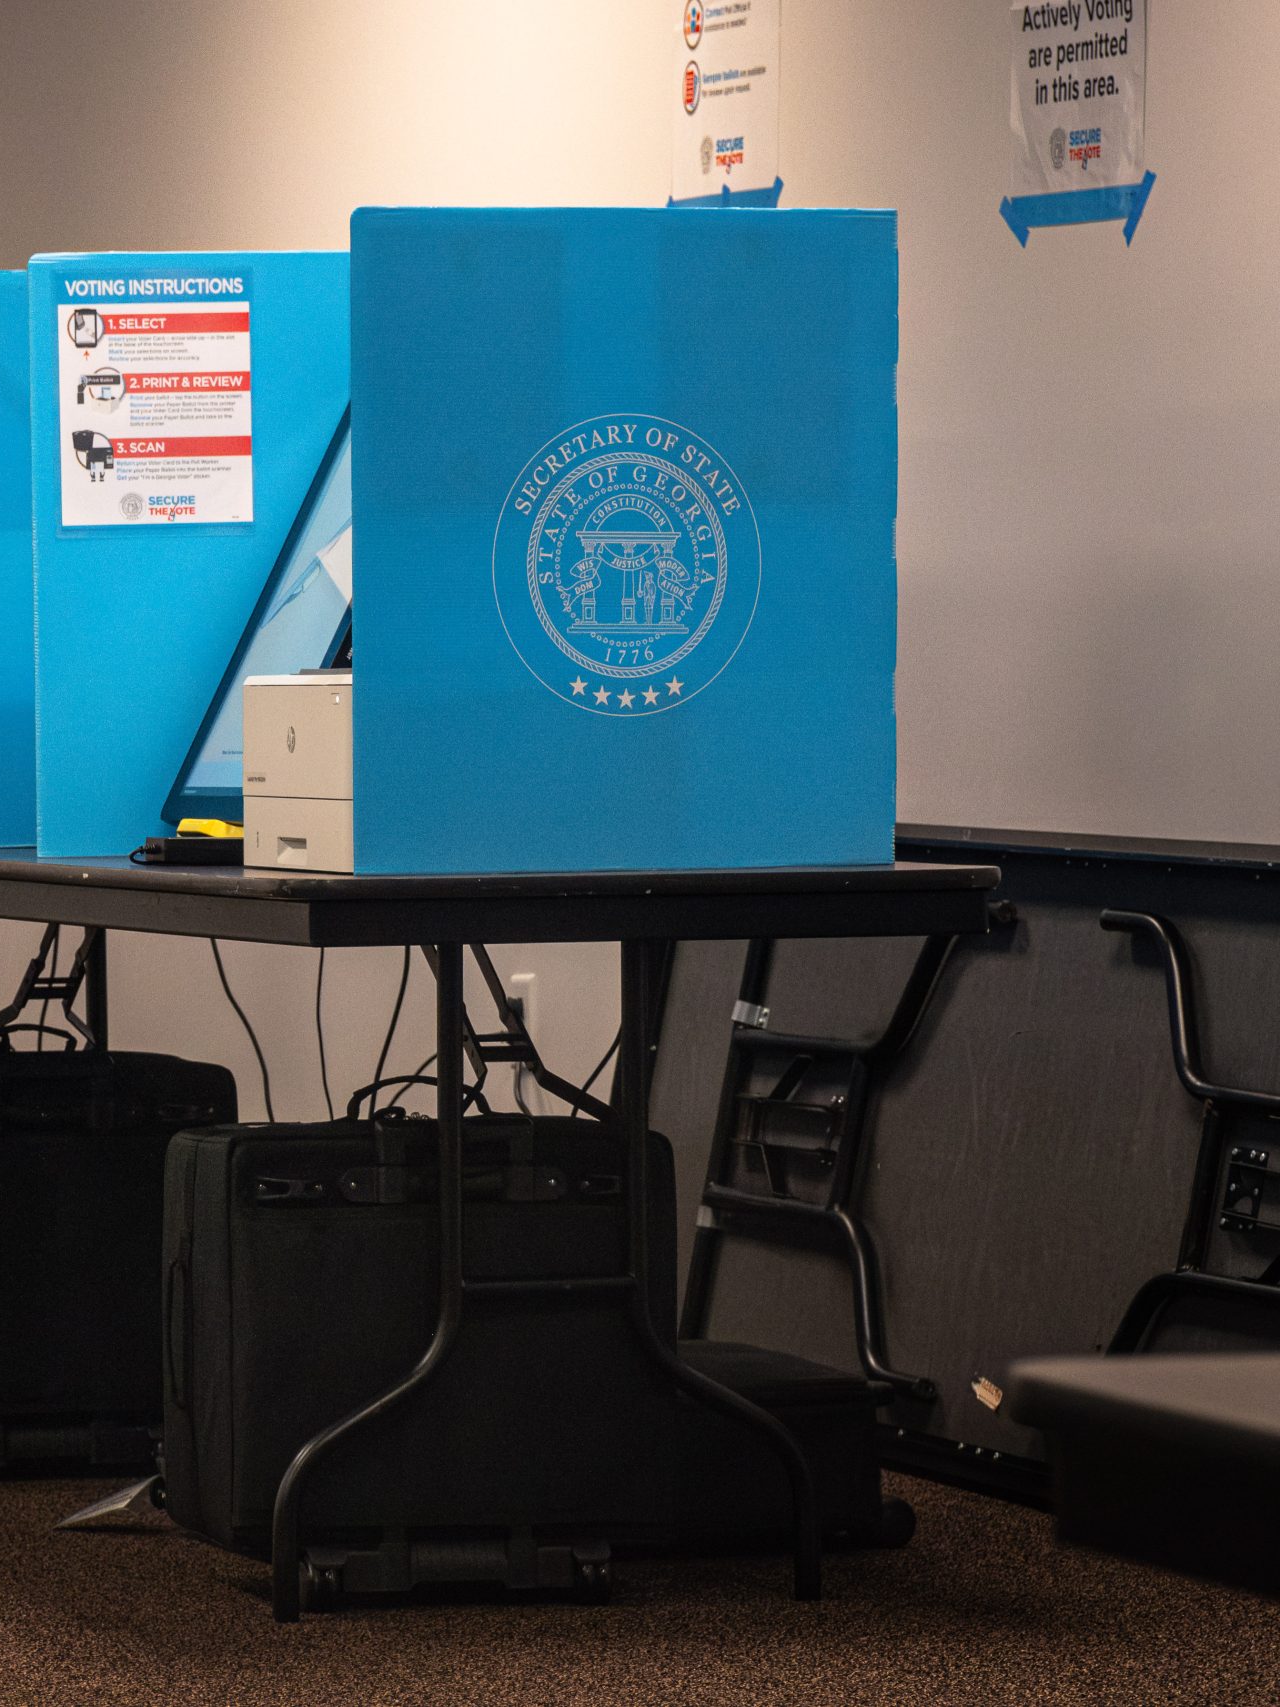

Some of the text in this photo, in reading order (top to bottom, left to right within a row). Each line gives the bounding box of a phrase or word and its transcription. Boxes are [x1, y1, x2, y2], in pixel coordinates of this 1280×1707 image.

[1022, 0, 1133, 32] Actively Voting
[1029, 28, 1128, 71] are permitted
[1035, 74, 1119, 105] in this area.
[716, 136, 744, 153] SECURE
[1069, 128, 1101, 146] SECURE
[65, 277, 244, 297] VOTING INSTRUCTIONS
[108, 317, 167, 330] 1. SELECT
[130, 375, 243, 389] 2. PRINT & REVIEW
[117, 441, 165, 453] 3. SCAN
[514, 424, 741, 517] SECRETARY OF STATE
[148, 495, 196, 506] SECURE
[148, 507, 168, 516] THE
[592, 497, 666, 527] CONSTITUTION
[539, 465, 716, 585] STATE OF GEORGIA
[578, 559, 595, 571] WIS
[611, 557, 647, 570] JUSTICE
[658, 560, 686, 578] MODER
[575, 580, 594, 595] DOM
[661, 580, 685, 597] ATION
[604, 646, 655, 665] 1776
